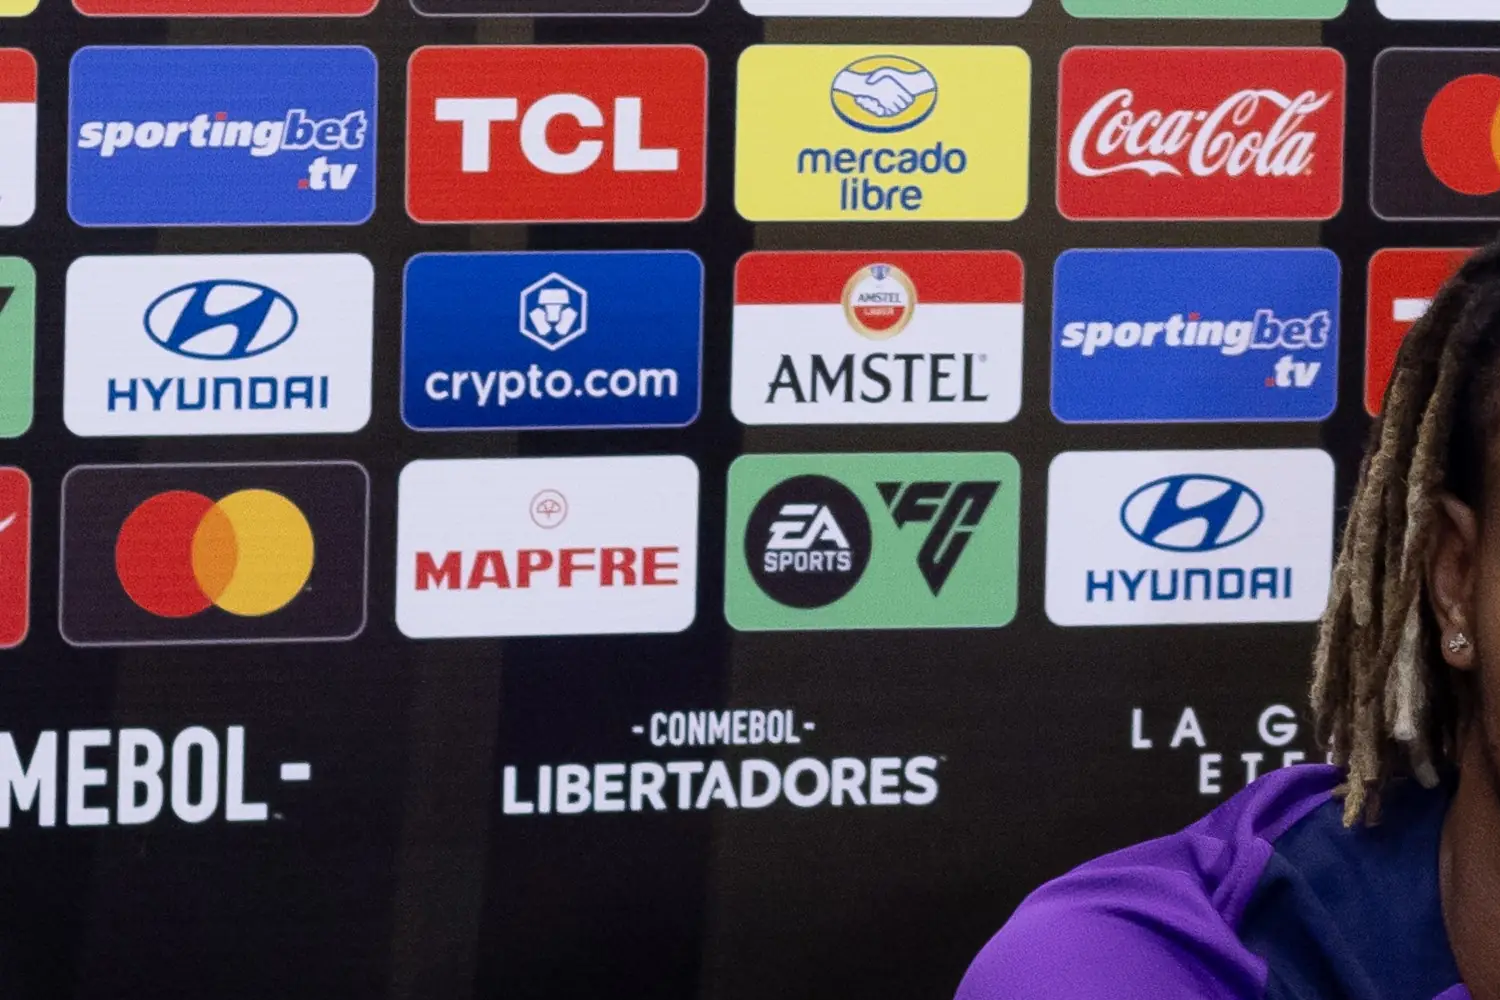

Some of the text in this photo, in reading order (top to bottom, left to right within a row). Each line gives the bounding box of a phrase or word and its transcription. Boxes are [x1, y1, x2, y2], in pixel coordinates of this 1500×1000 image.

[78, 109, 366, 157] sportingbet
[436, 93, 679, 174] TCL
[1068, 87, 1334, 178] Coca-Cola
[798, 141, 967, 175] mercado
[840, 178, 922, 211] libre
[1061, 308, 1332, 357] sportingbet
[107, 376, 329, 413] HYUNDAI
[425, 362, 679, 407] crypto.com
[765, 352, 989, 404] AMSTEL
[765, 503, 851, 549] EA
[413, 546, 681, 592] MAPFRE
[763, 549, 852, 574] SPORTS
[1085, 565, 1292, 603] HYUNDAI
[502, 755, 940, 816] LIBERTADORES
